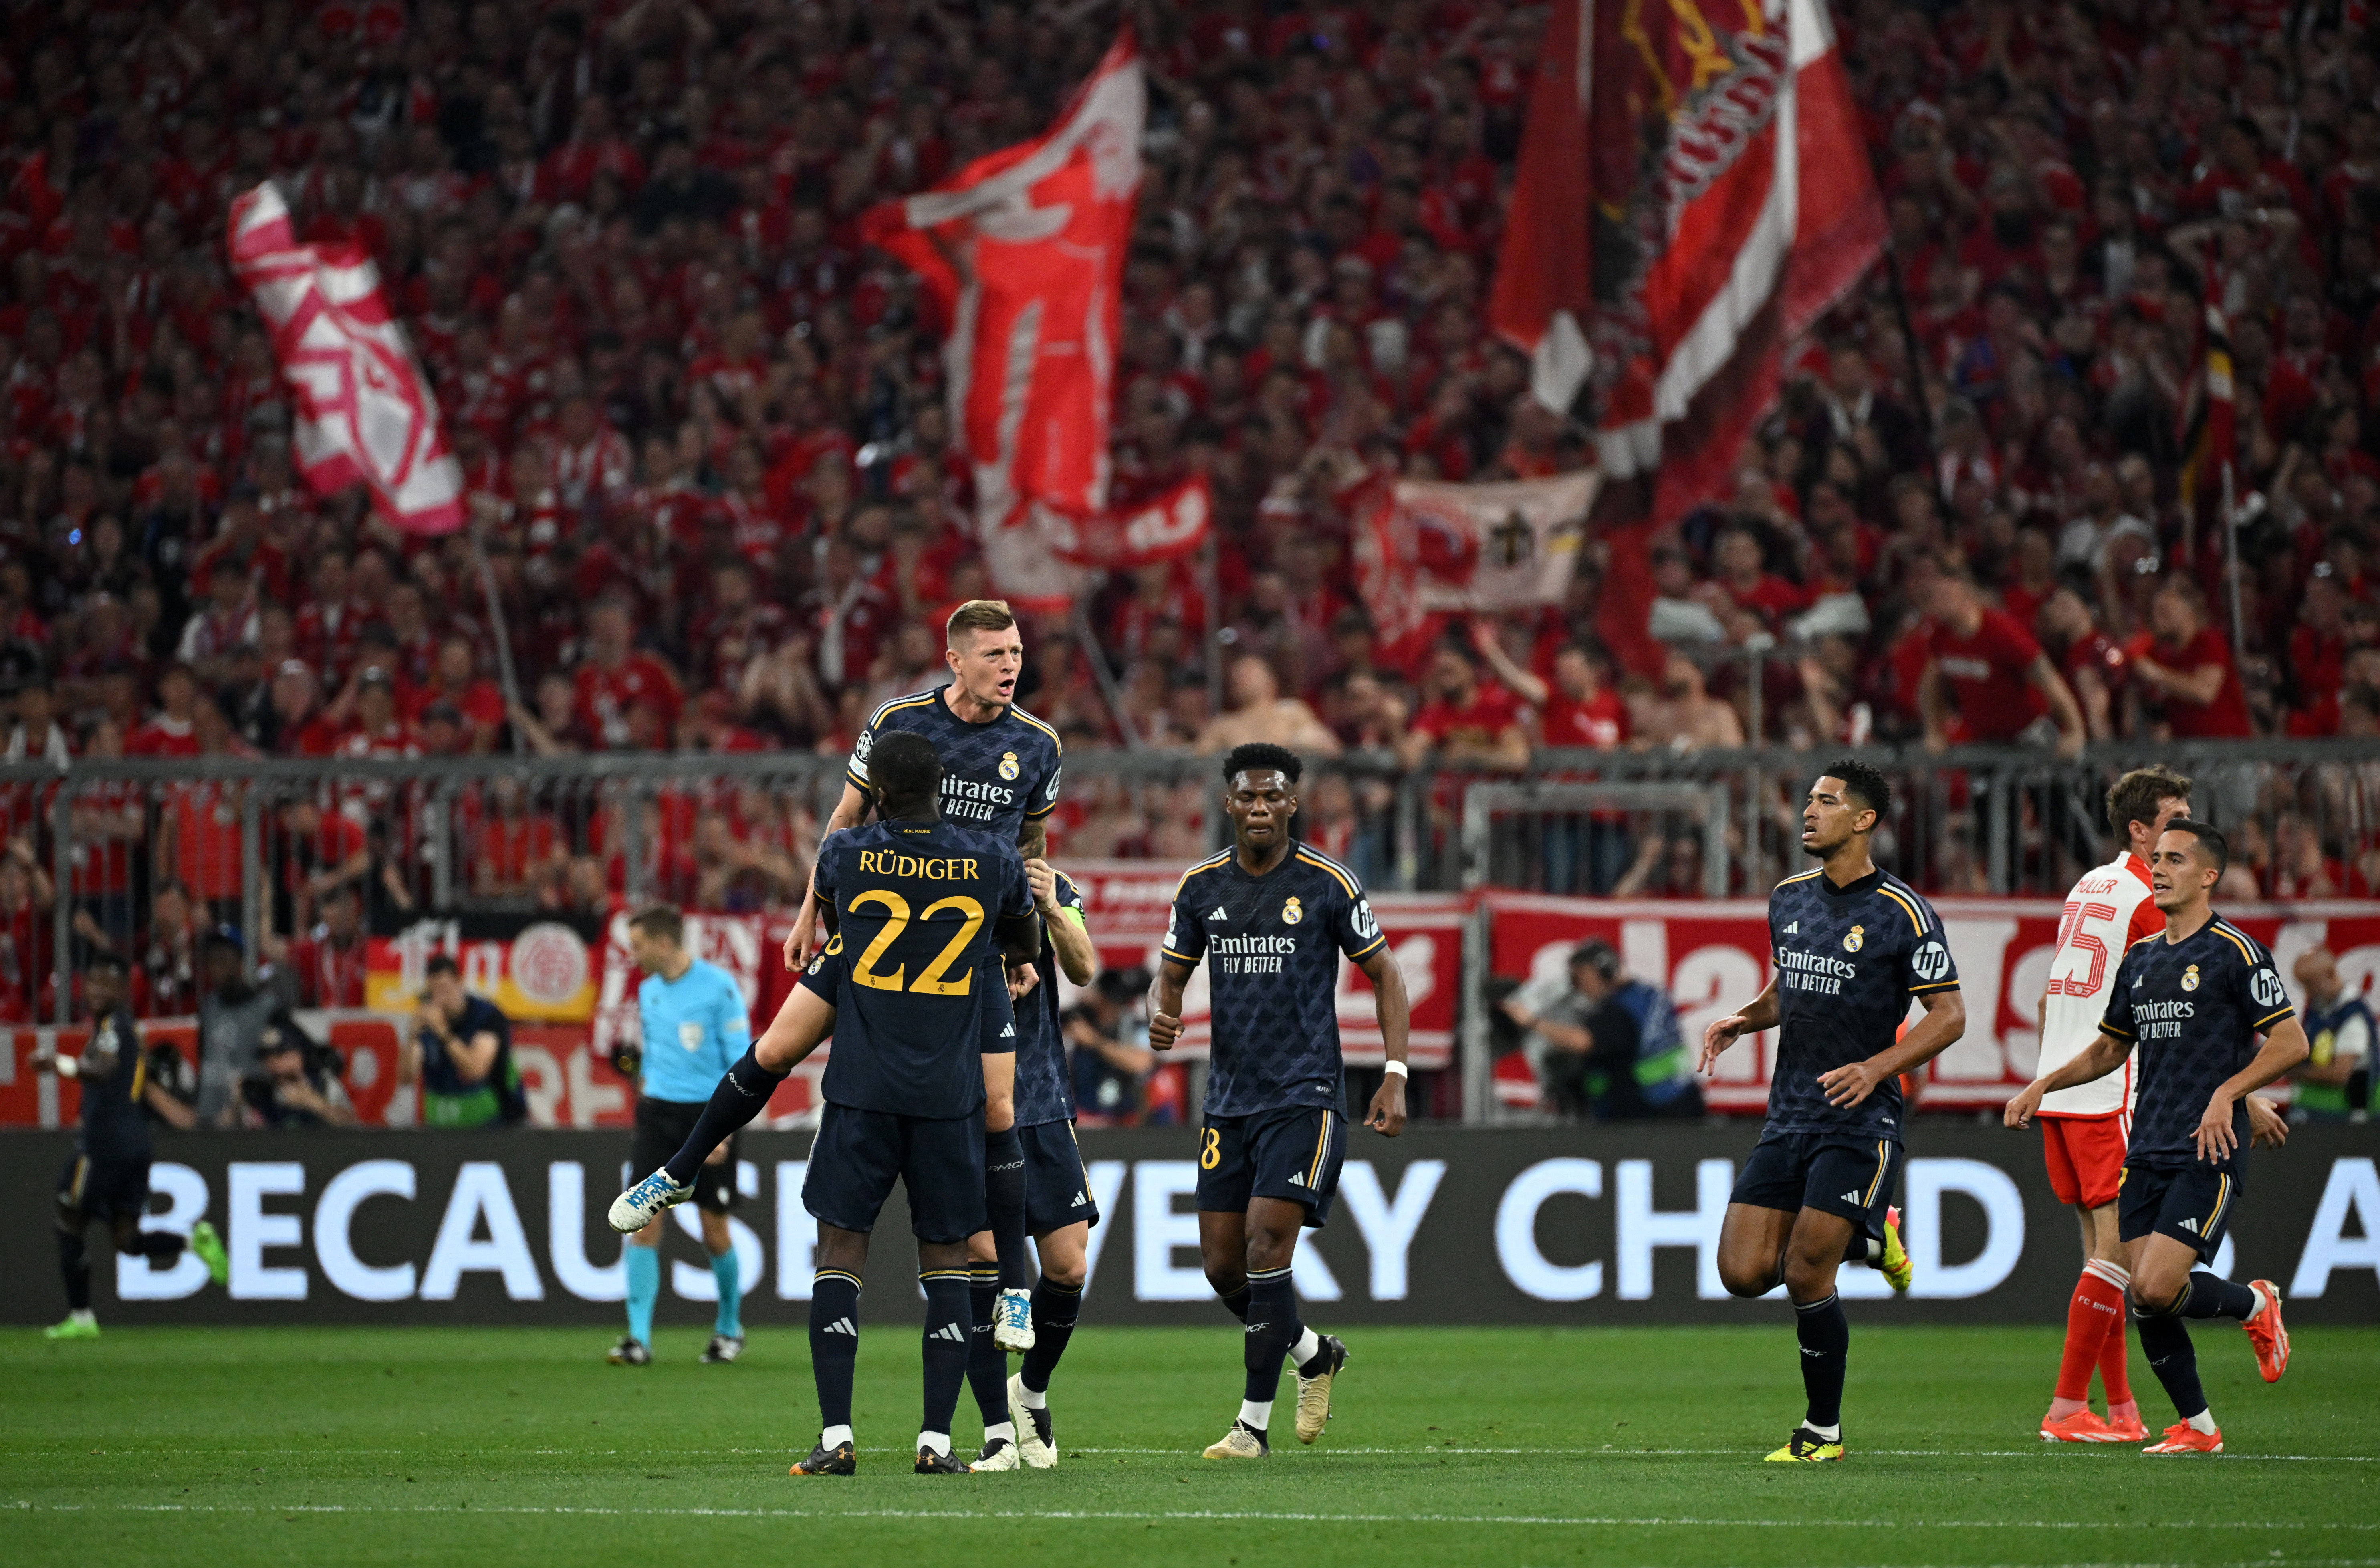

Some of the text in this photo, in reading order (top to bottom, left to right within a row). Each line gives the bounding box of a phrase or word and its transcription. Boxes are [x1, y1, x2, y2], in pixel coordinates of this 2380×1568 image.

[941, 774, 1013, 804] irates
[946, 798, 994, 821] BETTER
[859, 849, 979, 880] RÜDIGER
[2073, 876, 2118, 894] MÜLLER
[847, 889, 984, 995] 22
[1210, 933, 1295, 954] Emirates
[1224, 957, 1282, 973] FLY BETTER
[1779, 947, 1855, 979] Emirates
[1917, 942, 1945, 980] hp
[1786, 971, 1841, 995] FLY BETTER
[2257, 969, 2280, 1006] hp
[2151, 1022, 2181, 1038] BETTER
[1493, 1157, 2025, 1302] CHD
[2078, 1295, 2091, 1305] FC
[1245, 1323, 1270, 1332] MCF
[1799, 1342, 1827, 1357] MCF
